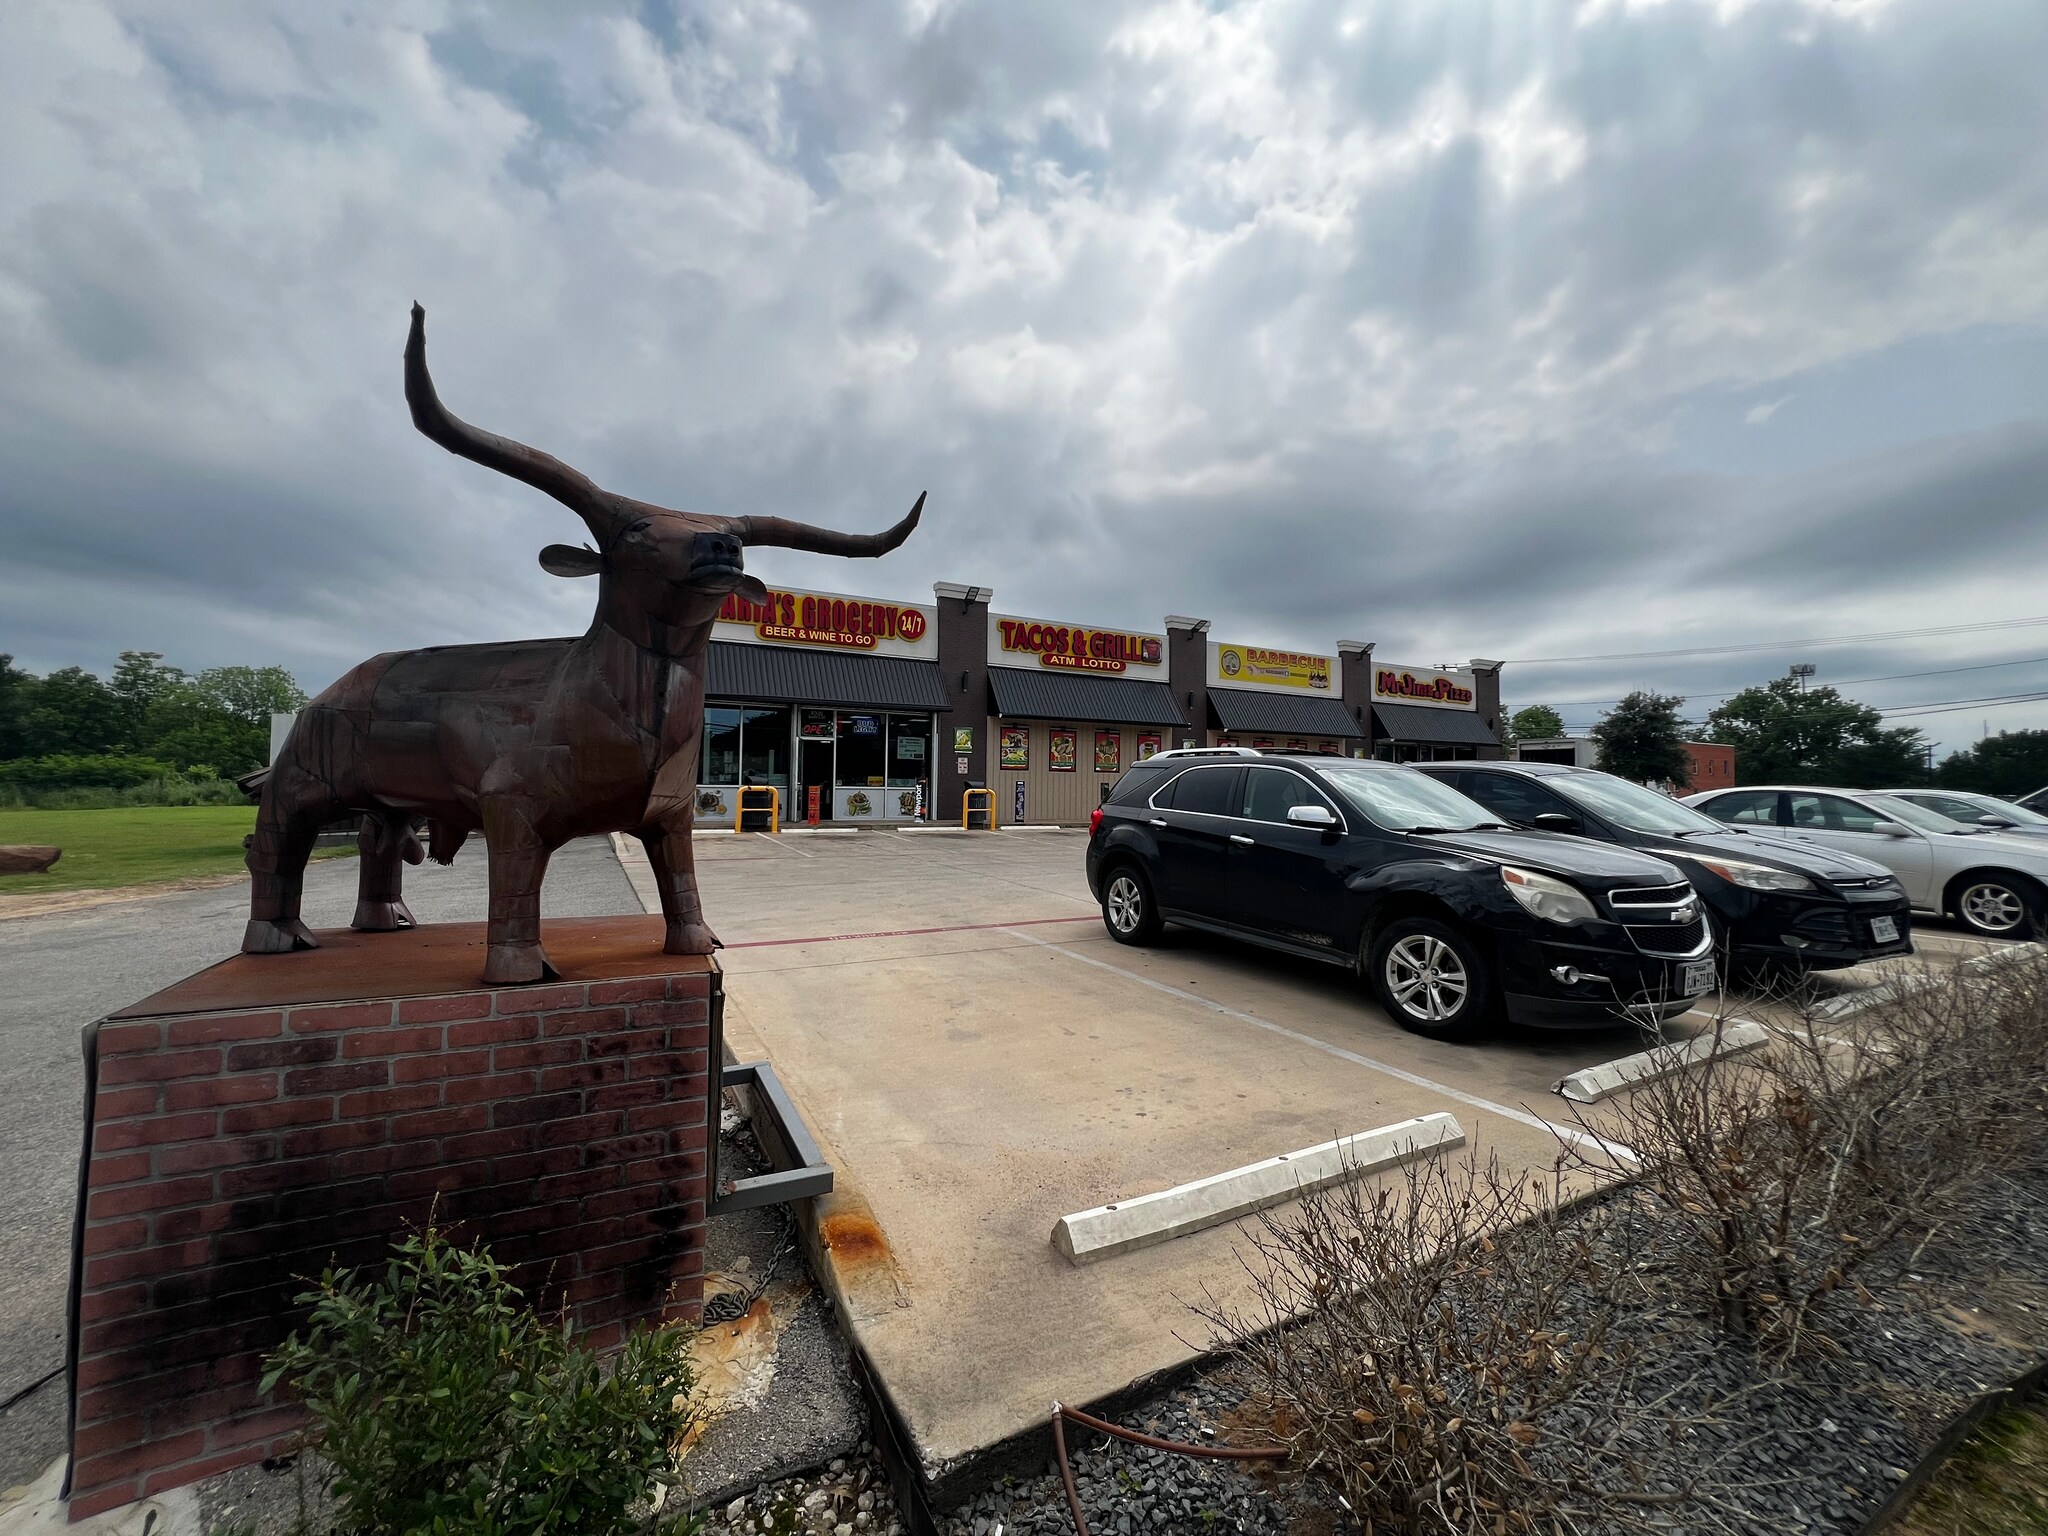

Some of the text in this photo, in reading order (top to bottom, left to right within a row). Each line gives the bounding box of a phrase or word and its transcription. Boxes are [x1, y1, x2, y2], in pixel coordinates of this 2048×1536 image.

[716, 592, 898, 637] ARIA'S GROCERY
[901, 615, 922, 632] 24/7
[765, 626, 872, 645] BEER & WINE TO GO
[1000, 621, 1143, 662] TACOS & GRILL
[1050, 655, 1121, 670] ATM LOTTO
[1246, 649, 1326, 671] BARBECUE
[914, 784, 923, 816] Newport
